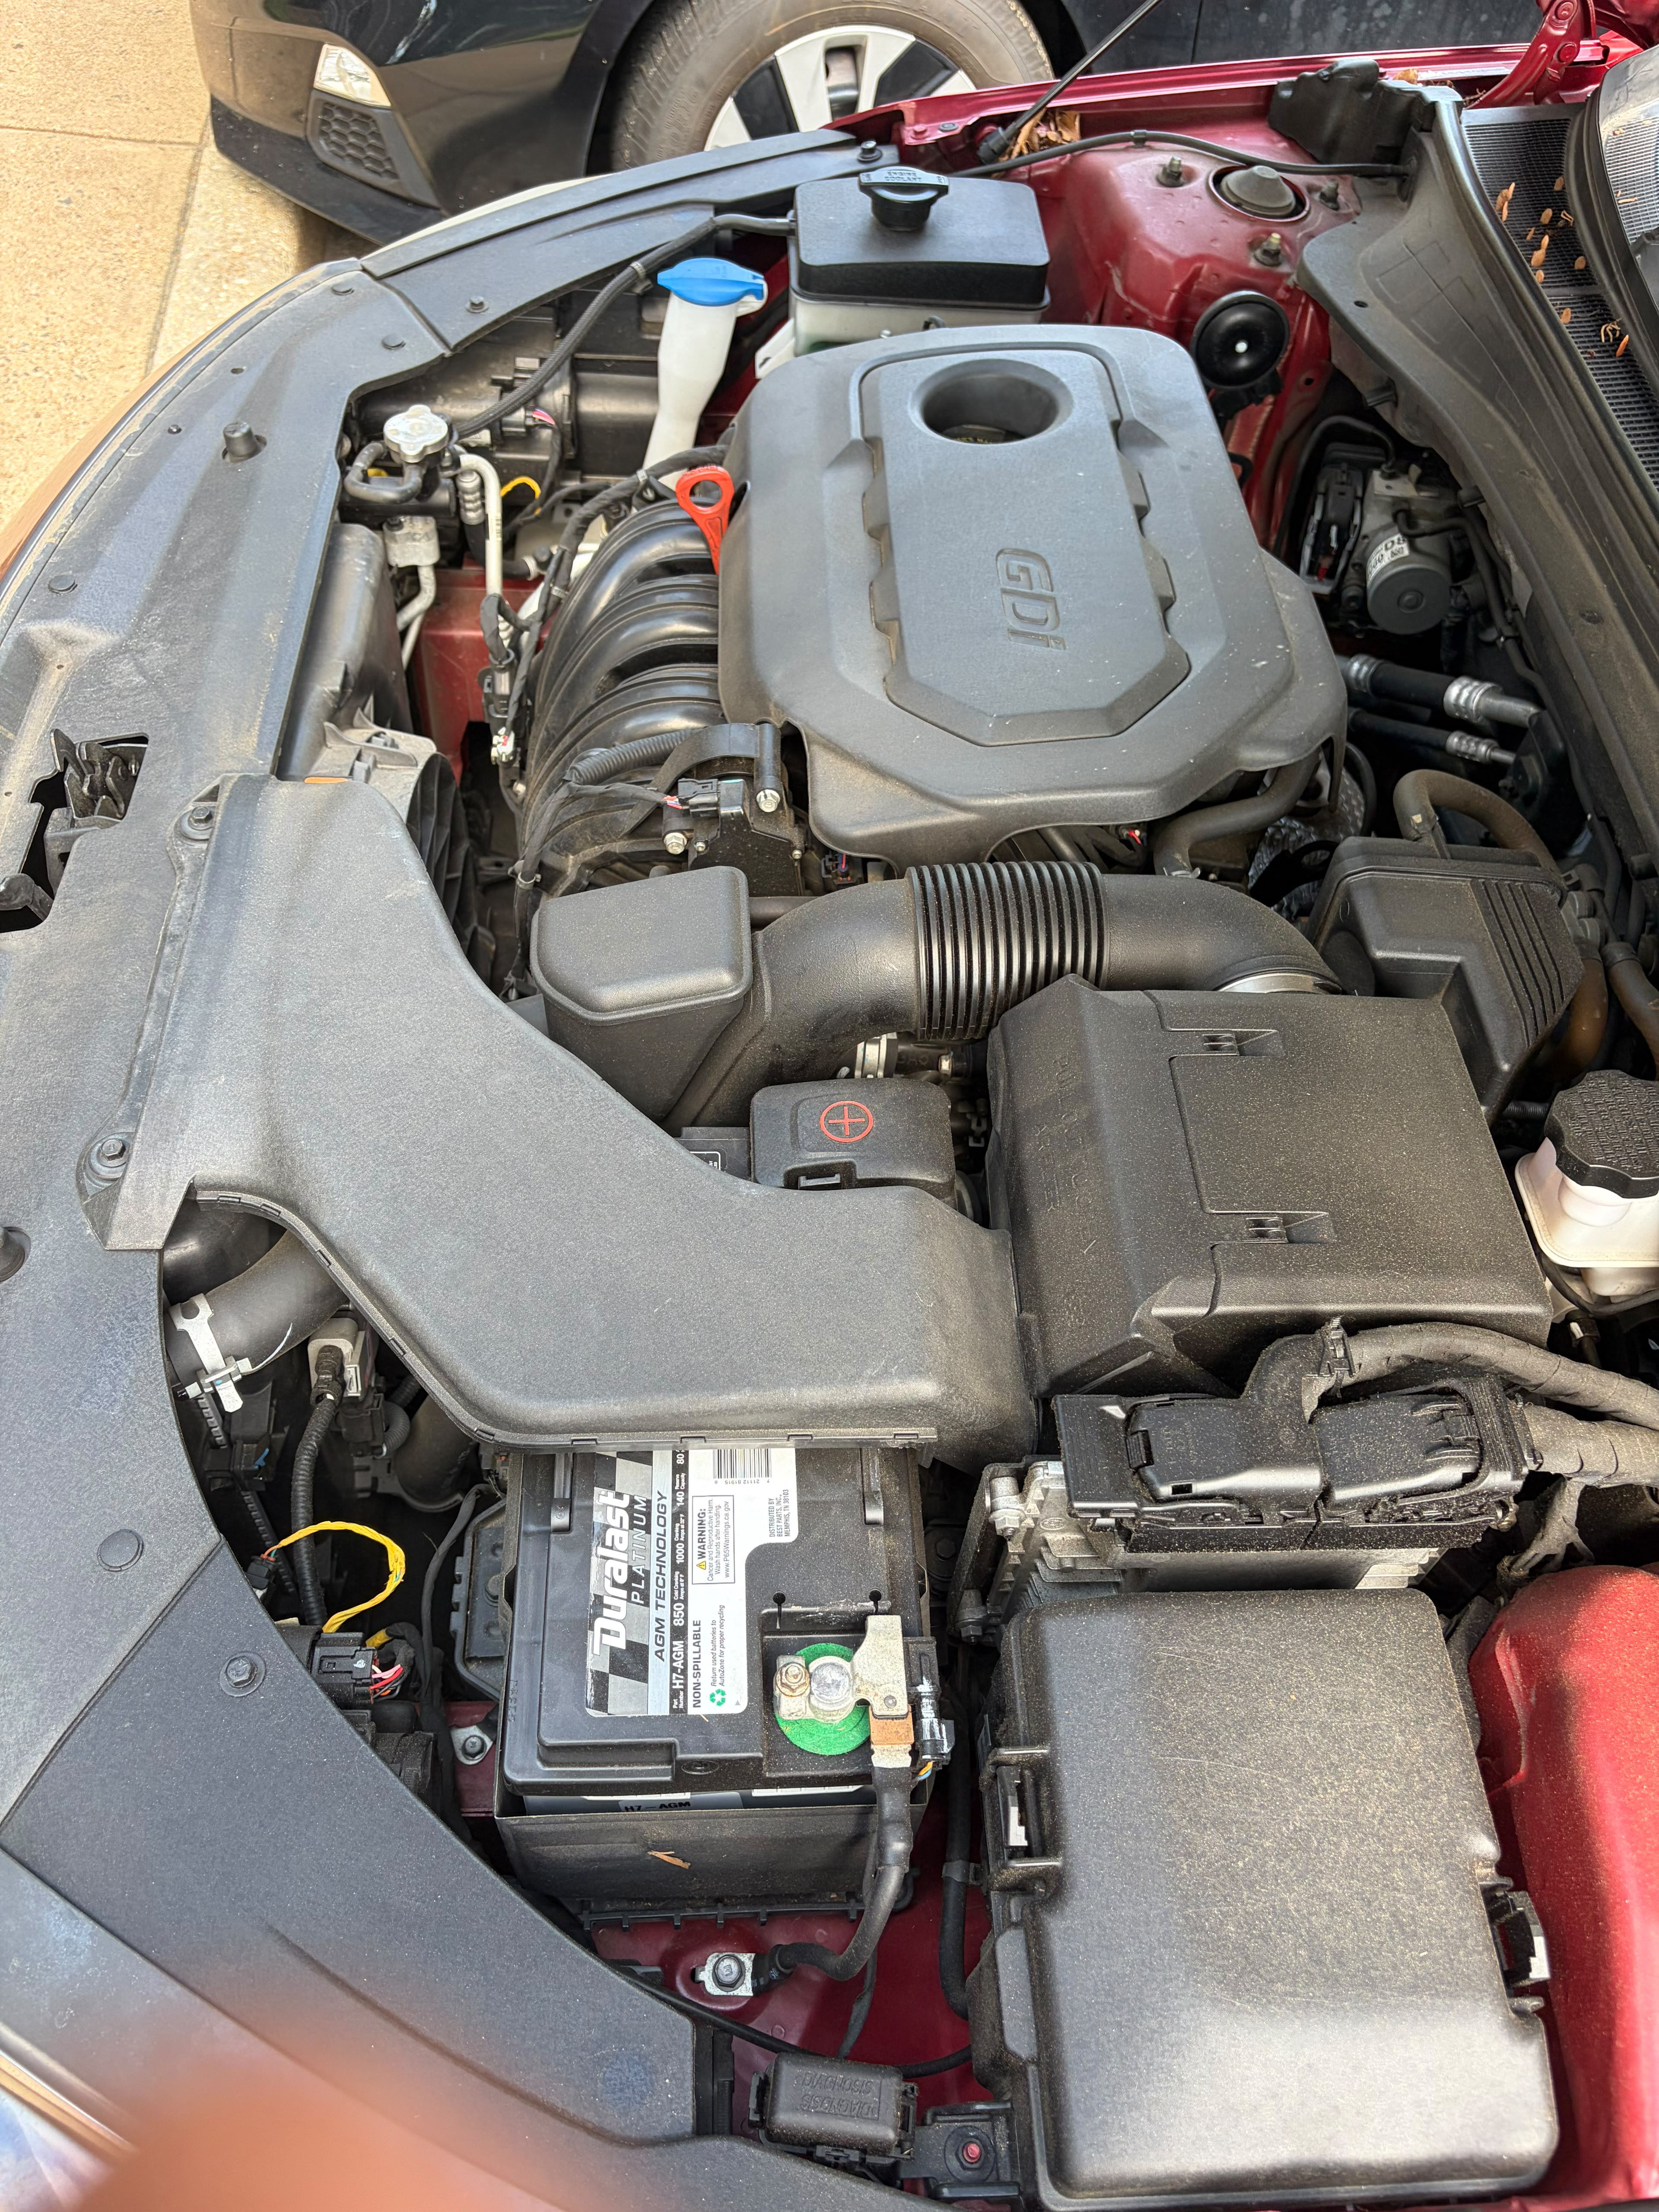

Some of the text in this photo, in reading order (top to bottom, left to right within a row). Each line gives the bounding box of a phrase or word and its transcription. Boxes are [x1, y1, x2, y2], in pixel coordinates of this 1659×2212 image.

[677, 1453, 684, 1464] 80
[632, 1495, 646, 1604] PLATINUM
[676, 1543, 684, 1564] 1000
[697, 1509, 706, 1559] WARNING:
[594, 1491, 629, 1656] Duralast
[655, 1490, 667, 1662] AGM TECHNOLOGY
[673, 1603, 684, 1626] 850
[672, 1641, 684, 1688] H7-AGM
